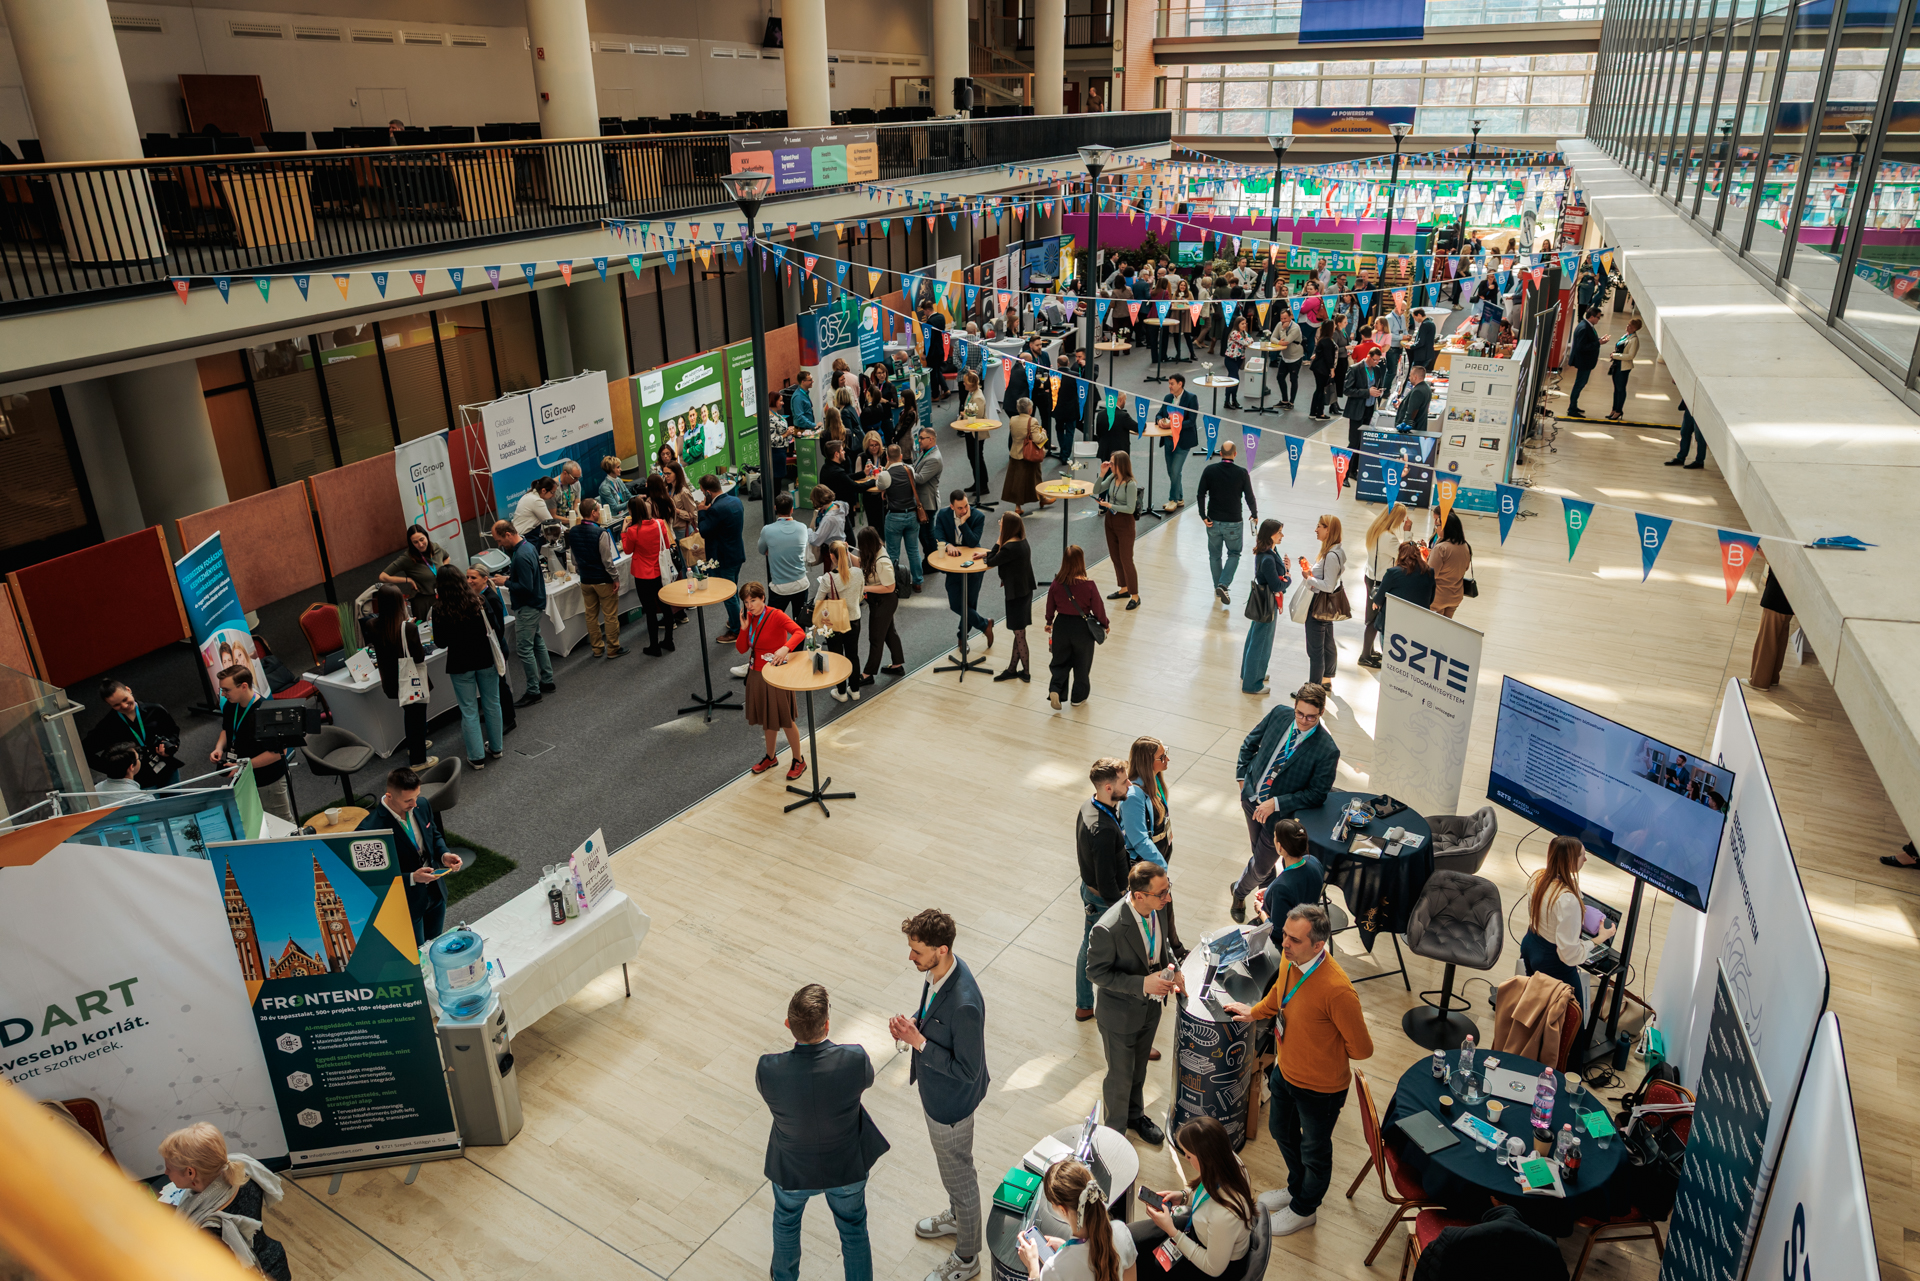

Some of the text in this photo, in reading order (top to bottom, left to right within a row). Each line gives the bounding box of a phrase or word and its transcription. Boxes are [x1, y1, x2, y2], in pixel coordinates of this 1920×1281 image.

[554, 404, 576, 416] Group
[495, 416, 514, 428] Globális
[496, 428, 512, 437] háttér
[498, 439, 516, 450] Lokális
[499, 445, 526, 460] tapasztalat
[423, 461, 444, 474] Group
[1388, 634, 1469, 693] SZTE
[1387, 663, 1465, 705] SZEGEDI TUDOMÁNYEGYETEM
[1620, 862, 1686, 900] DIPLOMÁN INNEN ÉS TÚL
[261, 984, 414, 1010] FRONTENDART
[278, 1011, 314, 1020] tapasztalat,
[82, 1016, 149, 1045] korlát.
[305, 1022, 354, 1031] AI-megoldások,
[349, 1039, 388, 1048] time-to-market
[44, 1041, 123, 1072] szoftverek.
[337, 1050, 394, 1060] szoftverfejlesztés,
[316, 1061, 351, 1069] befektetés
[325, 1068, 360, 1076] Testreszabott
[358, 1071, 393, 1079] versenyelőny
[328, 1079, 369, 1088] Zökkenőmentes
[325, 1092, 379, 1102] Szoftvertesztelés,
[352, 1110, 389, 1118] hibafelismerés
[385, 1113, 419, 1121] transzparens
[309, 1148, 363, 1158] info@frontendart.com
